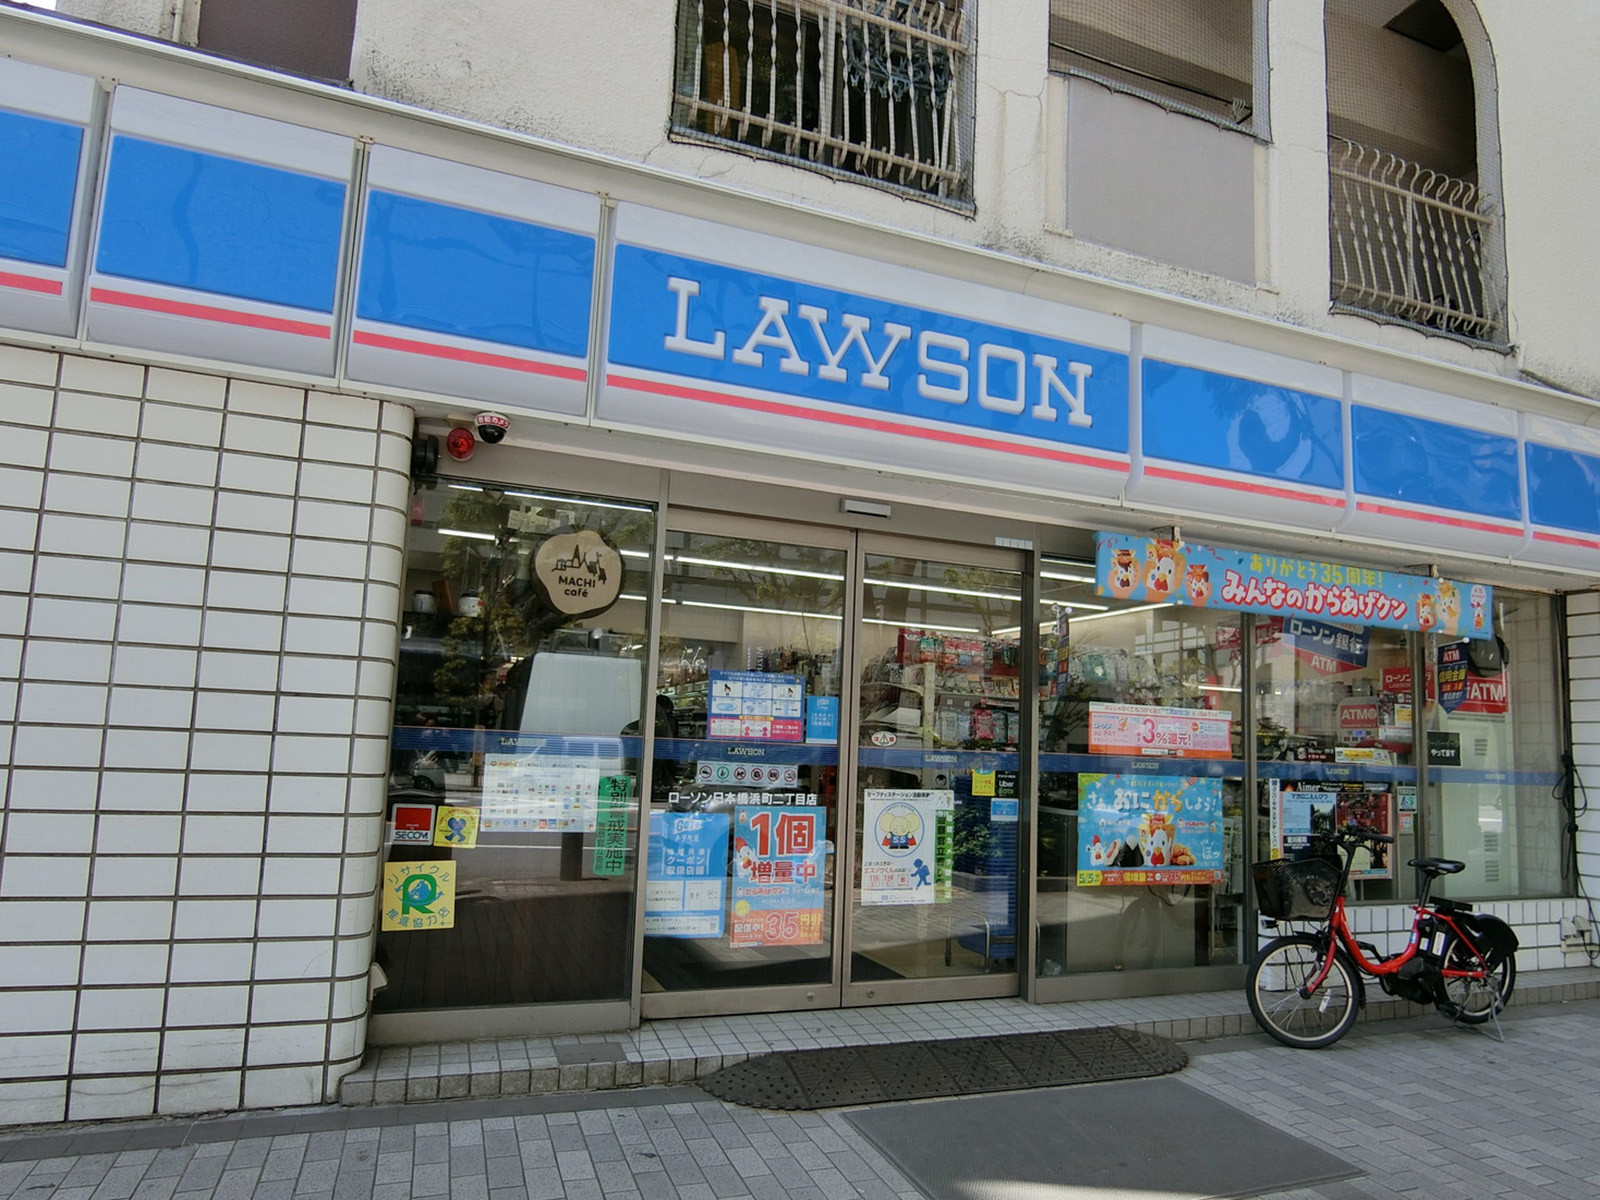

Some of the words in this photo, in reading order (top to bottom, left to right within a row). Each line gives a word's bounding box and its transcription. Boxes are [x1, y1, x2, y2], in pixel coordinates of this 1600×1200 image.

[664, 276, 1093, 428] LAWSON
[559, 575, 596, 588] MACHI
[564, 588, 589, 597] café
[1222, 569, 1408, 620] みんなのからあげクン
[1290, 619, 1365, 655] ローソン銀行
[1443, 649, 1460, 662] ATM
[1311, 655, 1337, 673] ATM
[1342, 708, 1367, 720] ATM
[727, 747, 765, 756] LAWSON
[998, 780, 1014, 788] Uber
[1296, 782, 1321, 792] Aimer
[395, 831, 428, 840] SECOM
[751, 811, 817, 857] 1個
[667, 856, 705, 865] クーポン
[388, 863, 450, 884] リサイクル
[750, 860, 817, 885] 増量中
